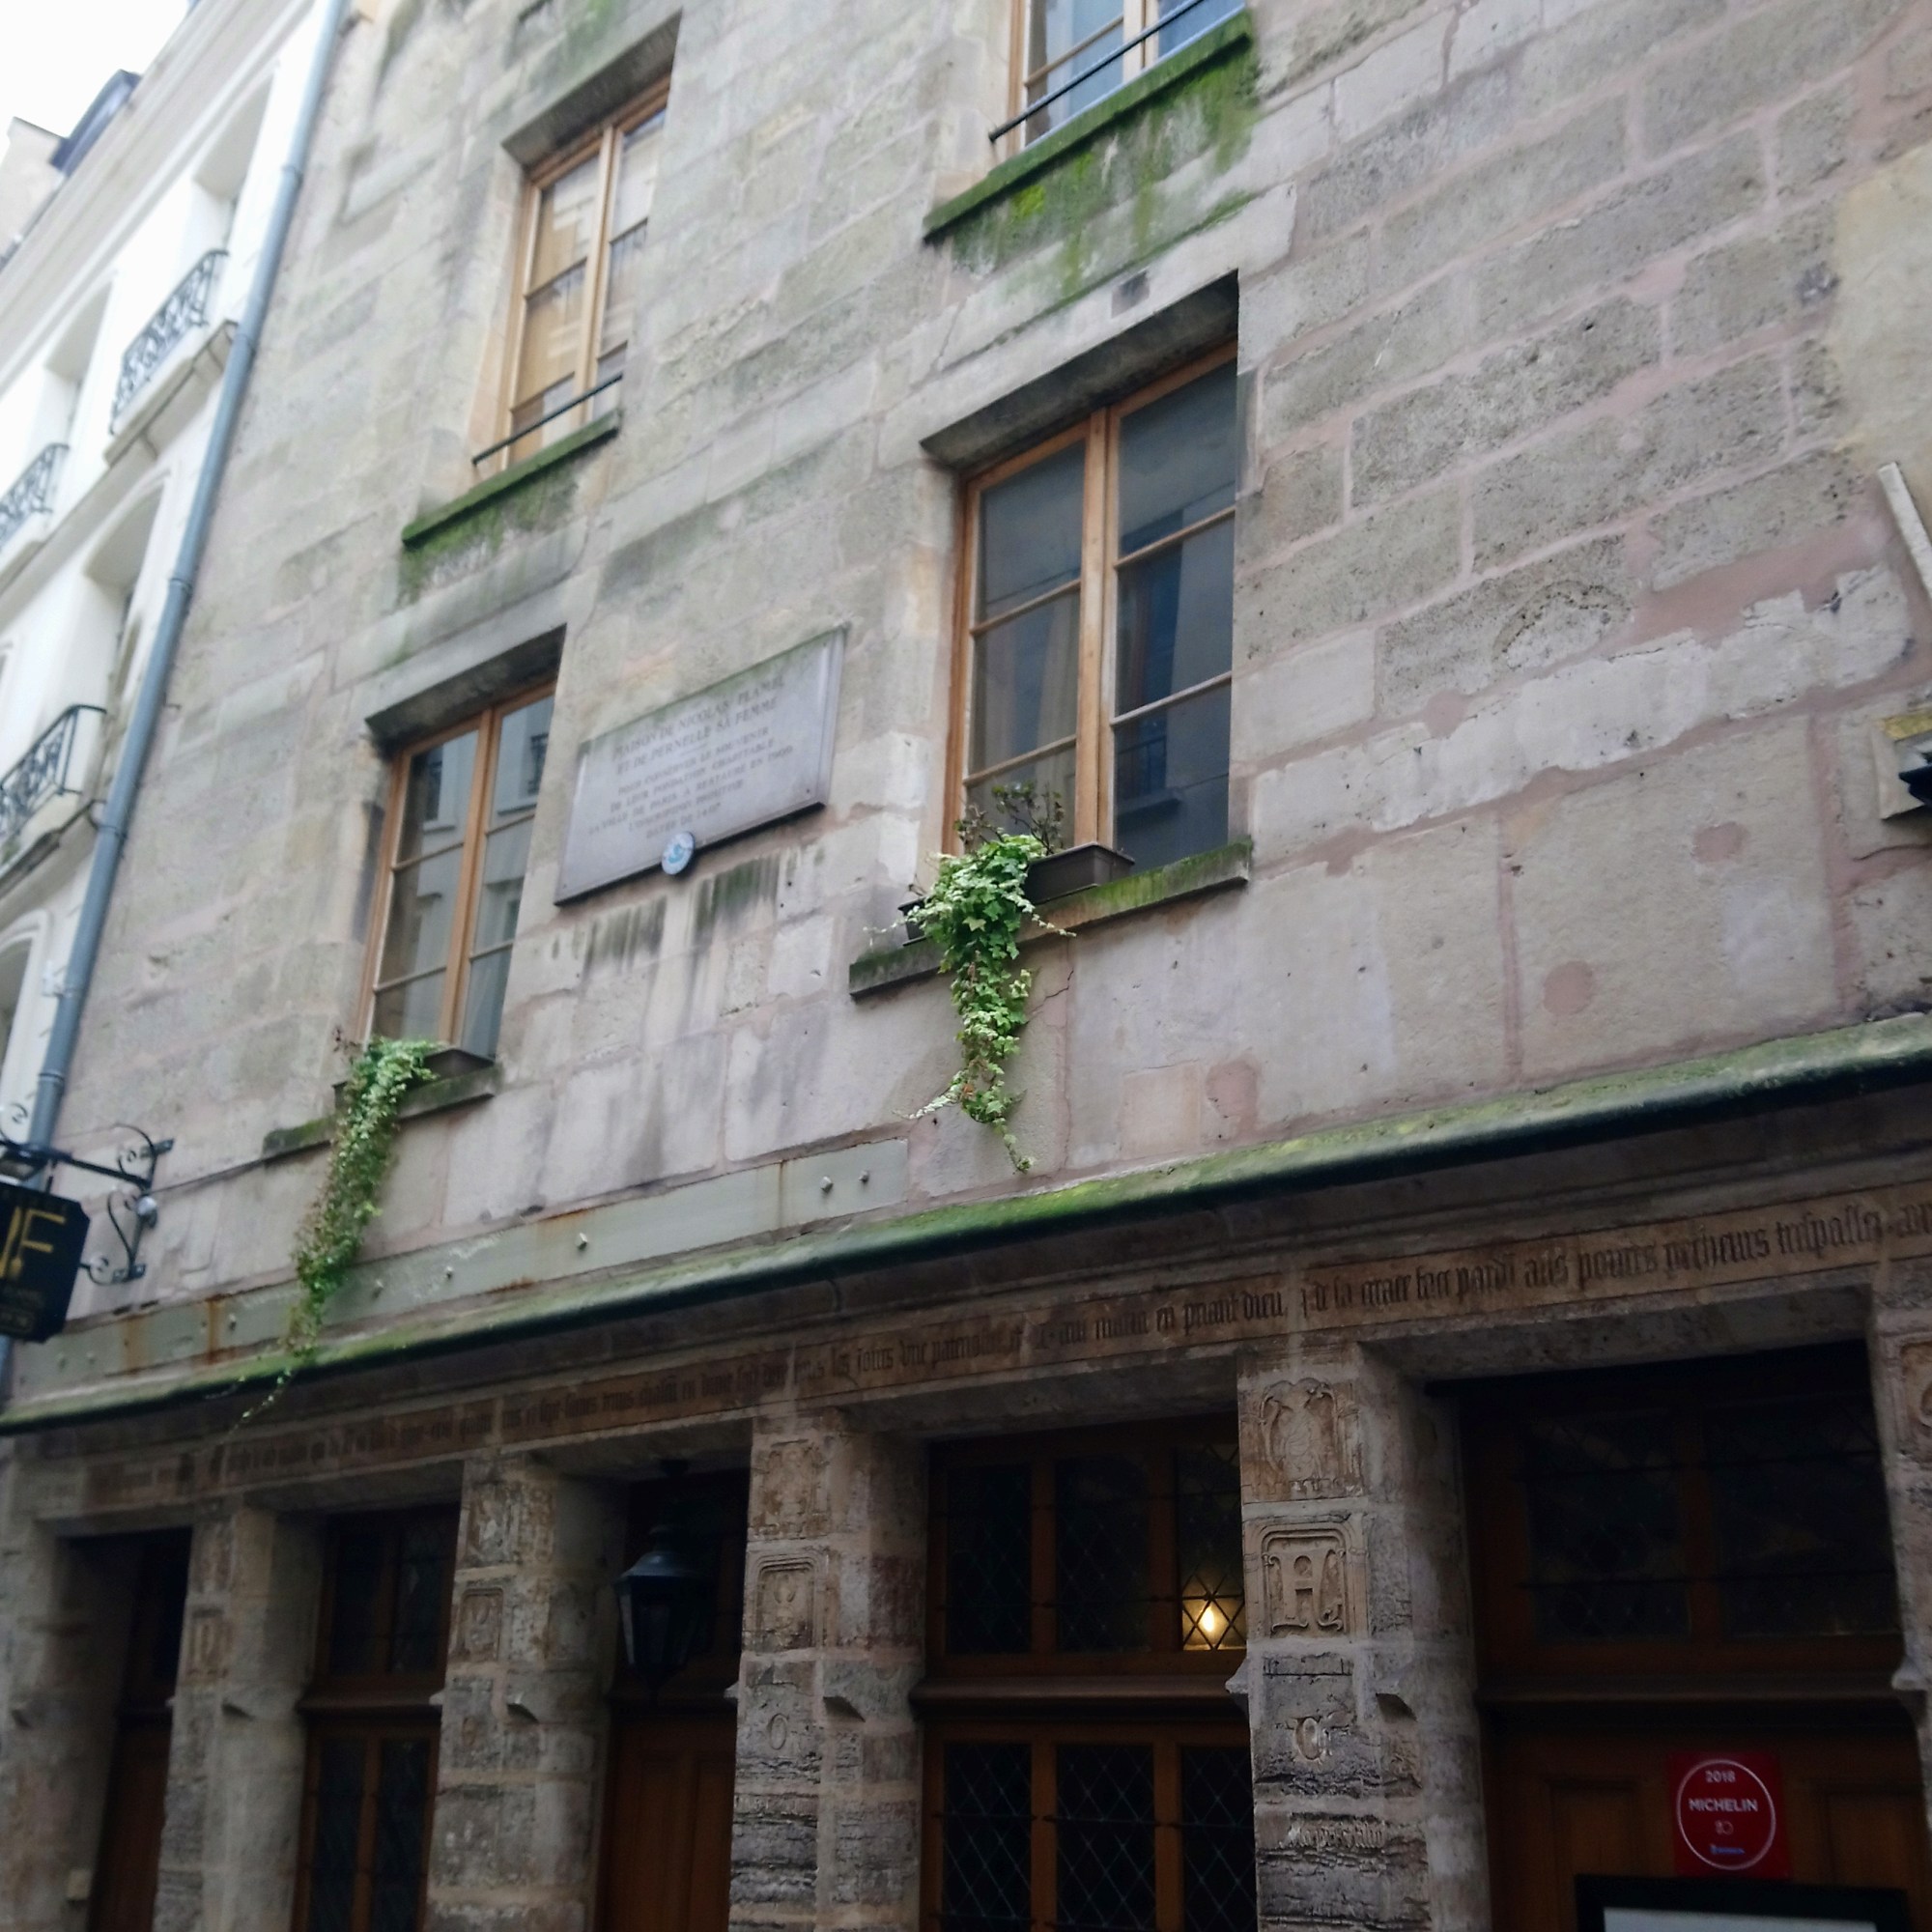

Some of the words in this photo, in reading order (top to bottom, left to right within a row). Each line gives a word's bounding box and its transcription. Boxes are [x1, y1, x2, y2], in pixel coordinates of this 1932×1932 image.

[611, 730, 656, 762] MAISON
[677, 696, 730, 732] NICOLAS
[736, 672, 785, 707] FLAMEL
[649, 724, 712, 761] PERNELLE
[733, 695, 778, 724] FEMME
[1705, 1770, 1736, 1783] 2018
[1688, 1797, 1759, 1812] MICHELIN
